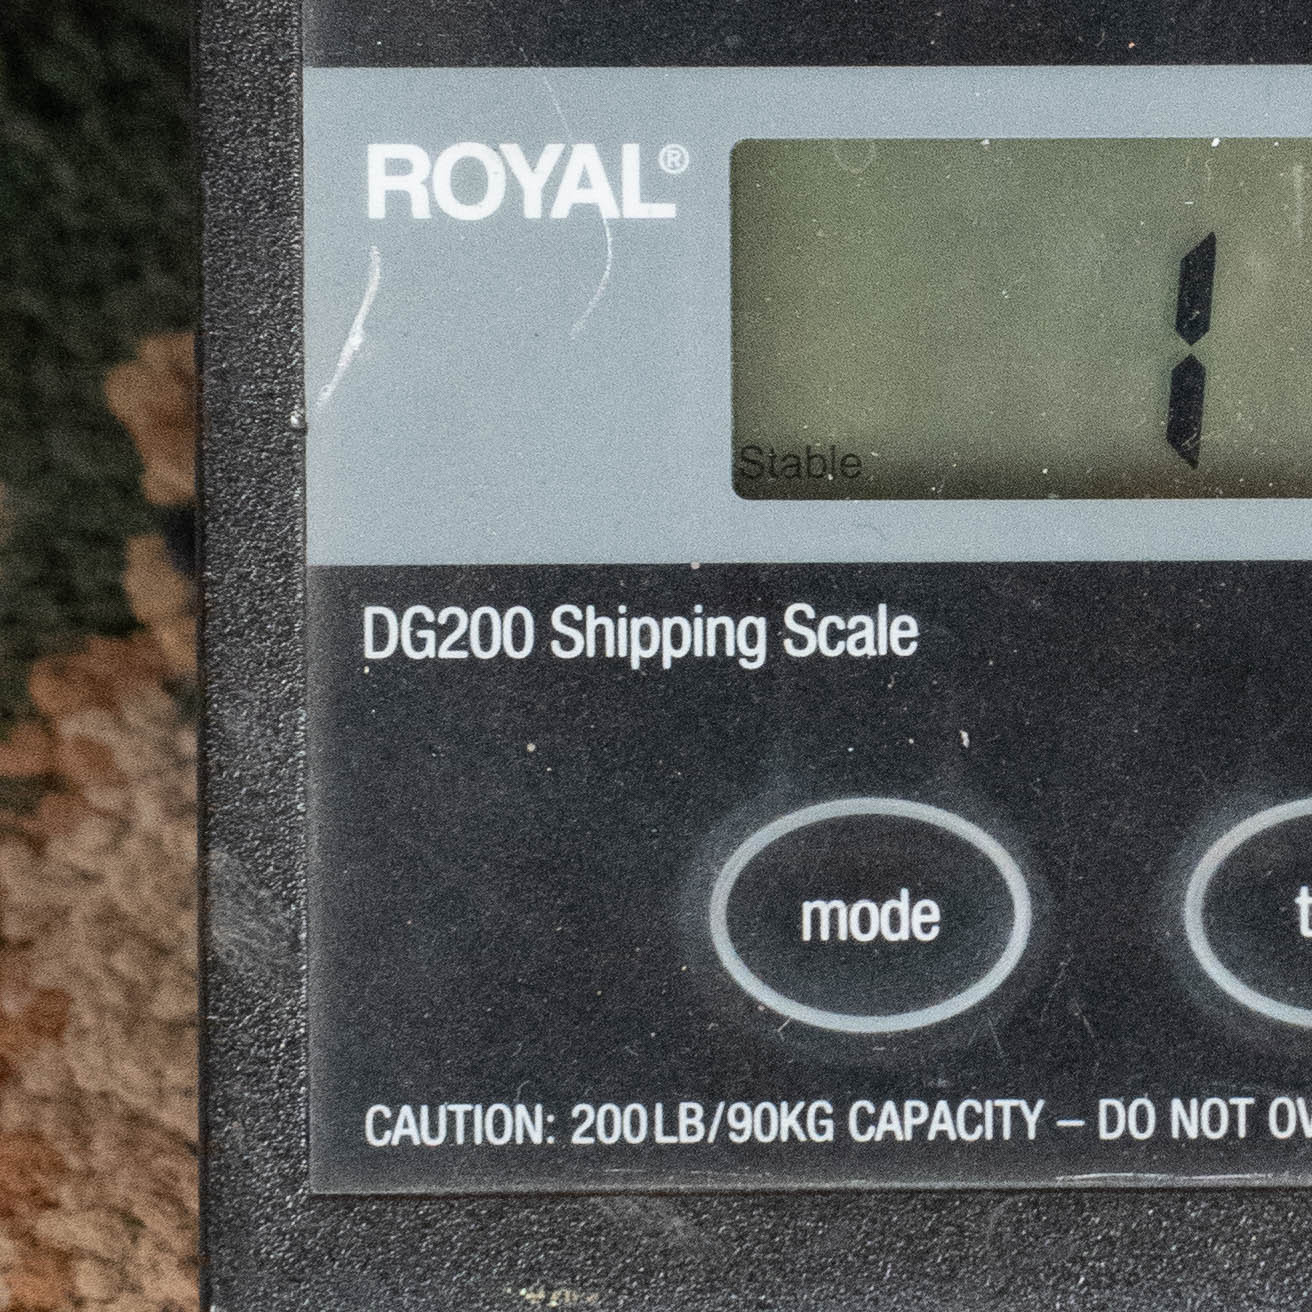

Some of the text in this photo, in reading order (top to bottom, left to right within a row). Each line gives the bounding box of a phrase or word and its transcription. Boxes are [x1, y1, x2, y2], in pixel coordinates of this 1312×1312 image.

[737, 444, 864, 481] Stable
[362, 603, 919, 669] DG200 Shipping Scale
[800, 887, 942, 942] mode
[364, 1104, 555, 1148] CAUTION:
[848, 1099, 1045, 1143] CAPACITY
[1097, 1097, 1157, 1141] DO
[1170, 1097, 1254, 1140] NOT
